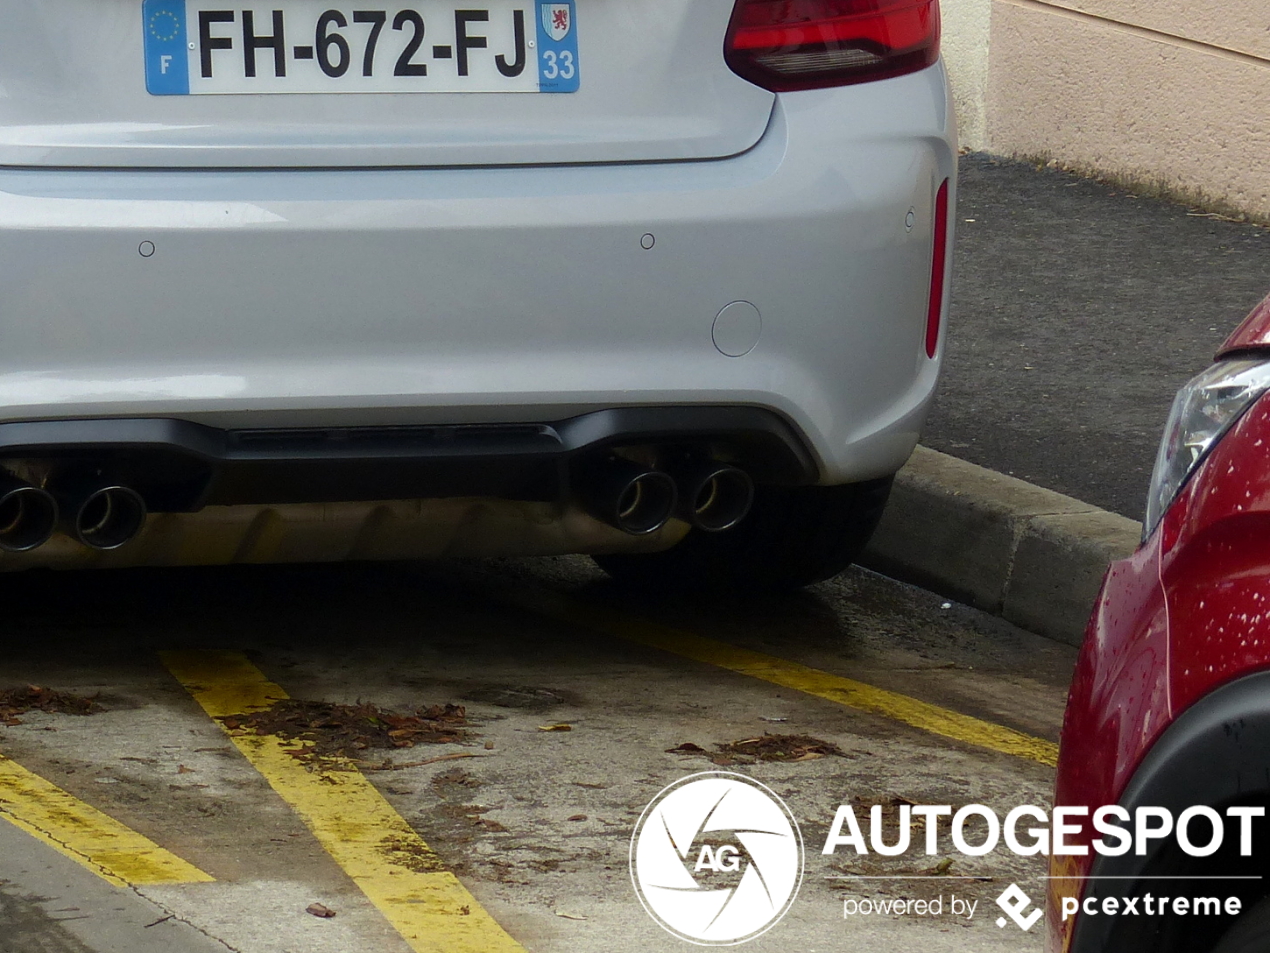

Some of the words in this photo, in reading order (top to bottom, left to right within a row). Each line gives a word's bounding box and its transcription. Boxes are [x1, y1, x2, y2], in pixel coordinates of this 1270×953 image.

[198, 8, 527, 79] FH-672-FJ
[160, 55, 172, 74] F
[543, 50, 575, 79] 33
